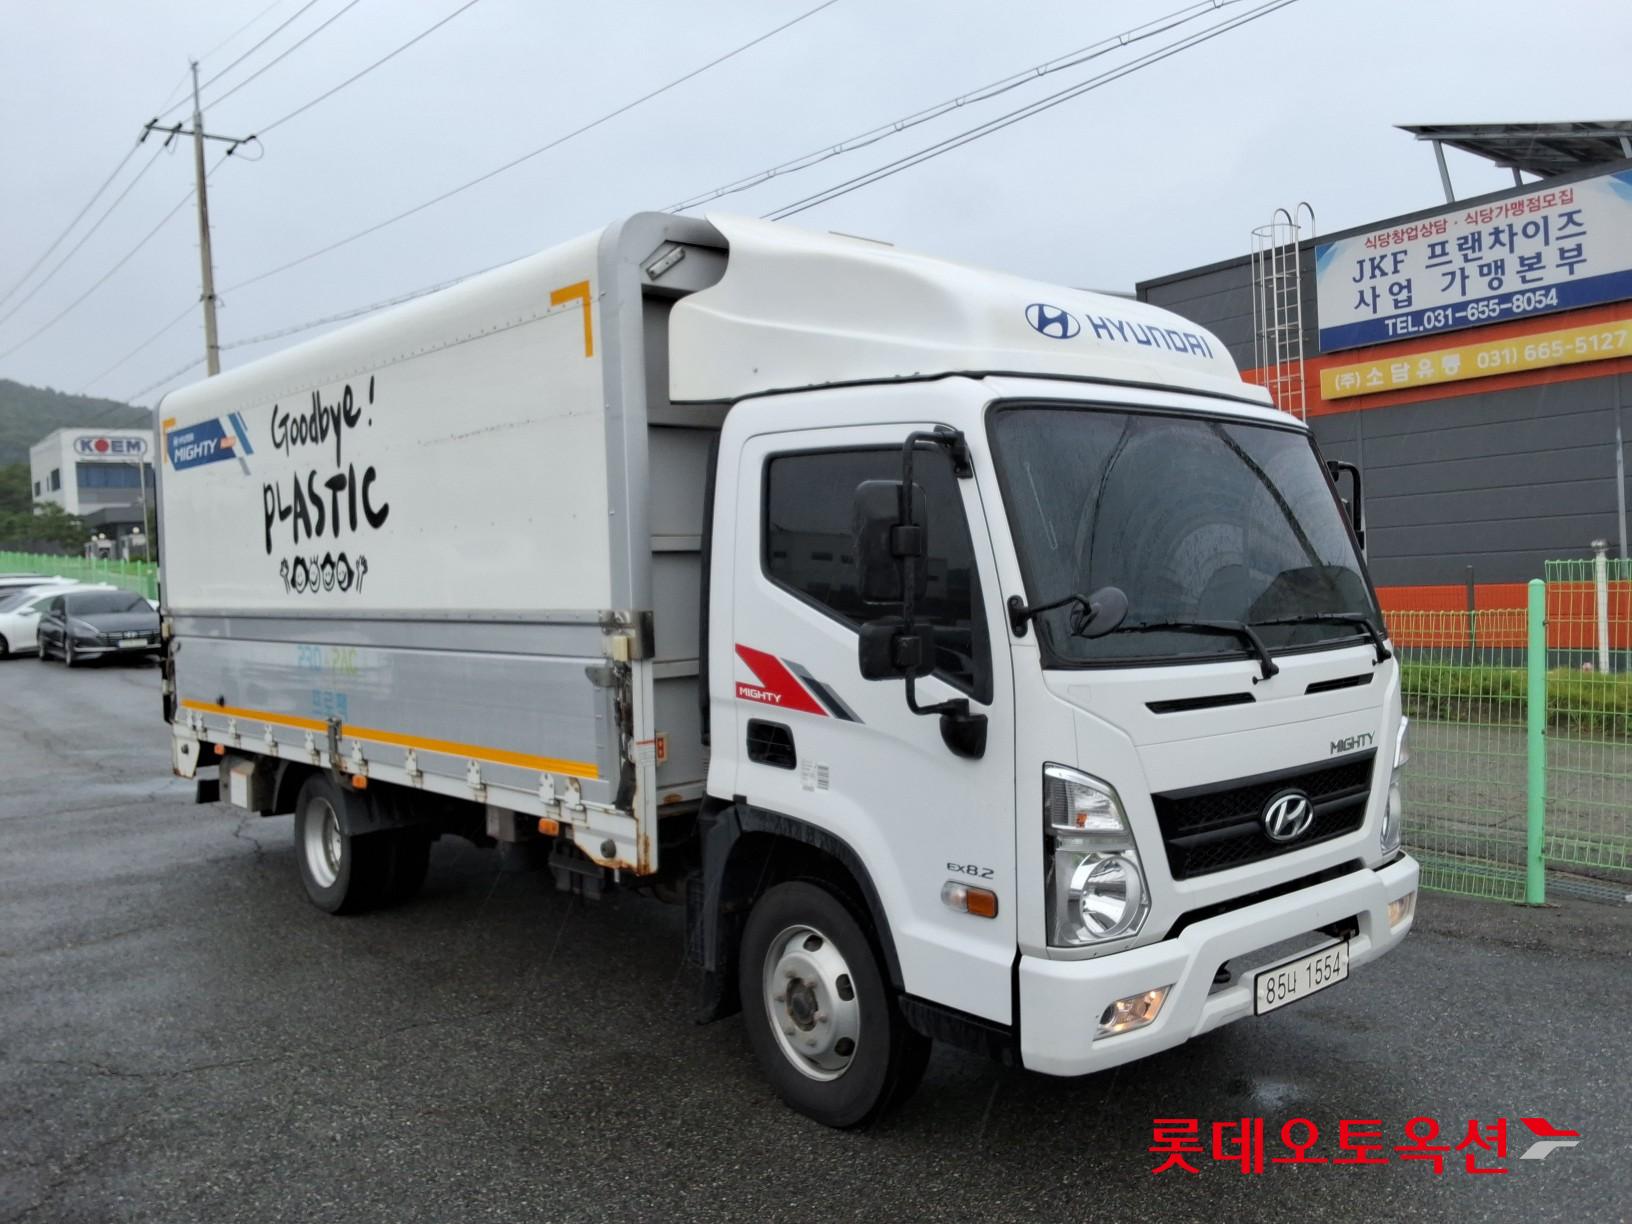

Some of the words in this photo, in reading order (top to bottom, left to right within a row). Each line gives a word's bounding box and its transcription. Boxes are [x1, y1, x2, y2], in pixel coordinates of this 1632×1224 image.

[1364, 218, 1448, 249] 식당창업상담
[1464, 188, 1574, 225] 식당가맹점모집
[1352, 249, 1408, 283] JKF
[1425, 209, 1587, 269] 프랜차이즈
[1354, 278, 1413, 314] 사업
[1441, 243, 1587, 297] 가맹본부
[1385, 288, 1558, 336] TEL.031-655-8054
[1085, 314, 1214, 359] HYUNDAI
[1524, 330, 1628, 362] 665-5127
[81, 438, 142, 454] KOEM
[174, 438, 218, 464] MIGHTY
[738, 686, 782, 703] MIGHTY
[1329, 730, 1376, 755] MIGHTY
[946, 862, 995, 880] EX8.2
[1306, 951, 1340, 988] 1554
